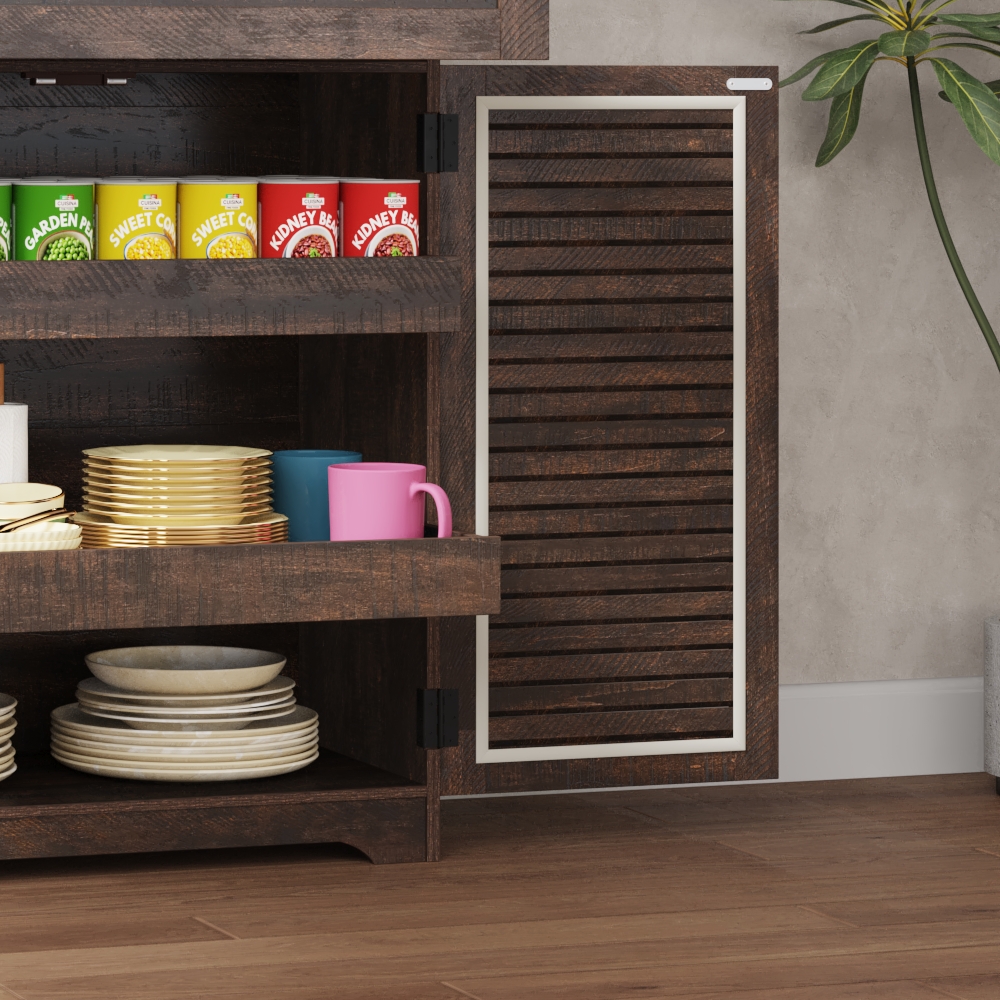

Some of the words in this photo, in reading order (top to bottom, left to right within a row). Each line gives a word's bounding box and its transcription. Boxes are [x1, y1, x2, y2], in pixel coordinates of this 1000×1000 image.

[24, 212, 78, 250] GARDEN
[79, 215, 93, 250] PEA
[109, 212, 153, 248] SWEET
[191, 211, 235, 247] SWEET
[269, 210, 317, 251] KIDNEY
[351, 209, 399, 250] KIDNEY
